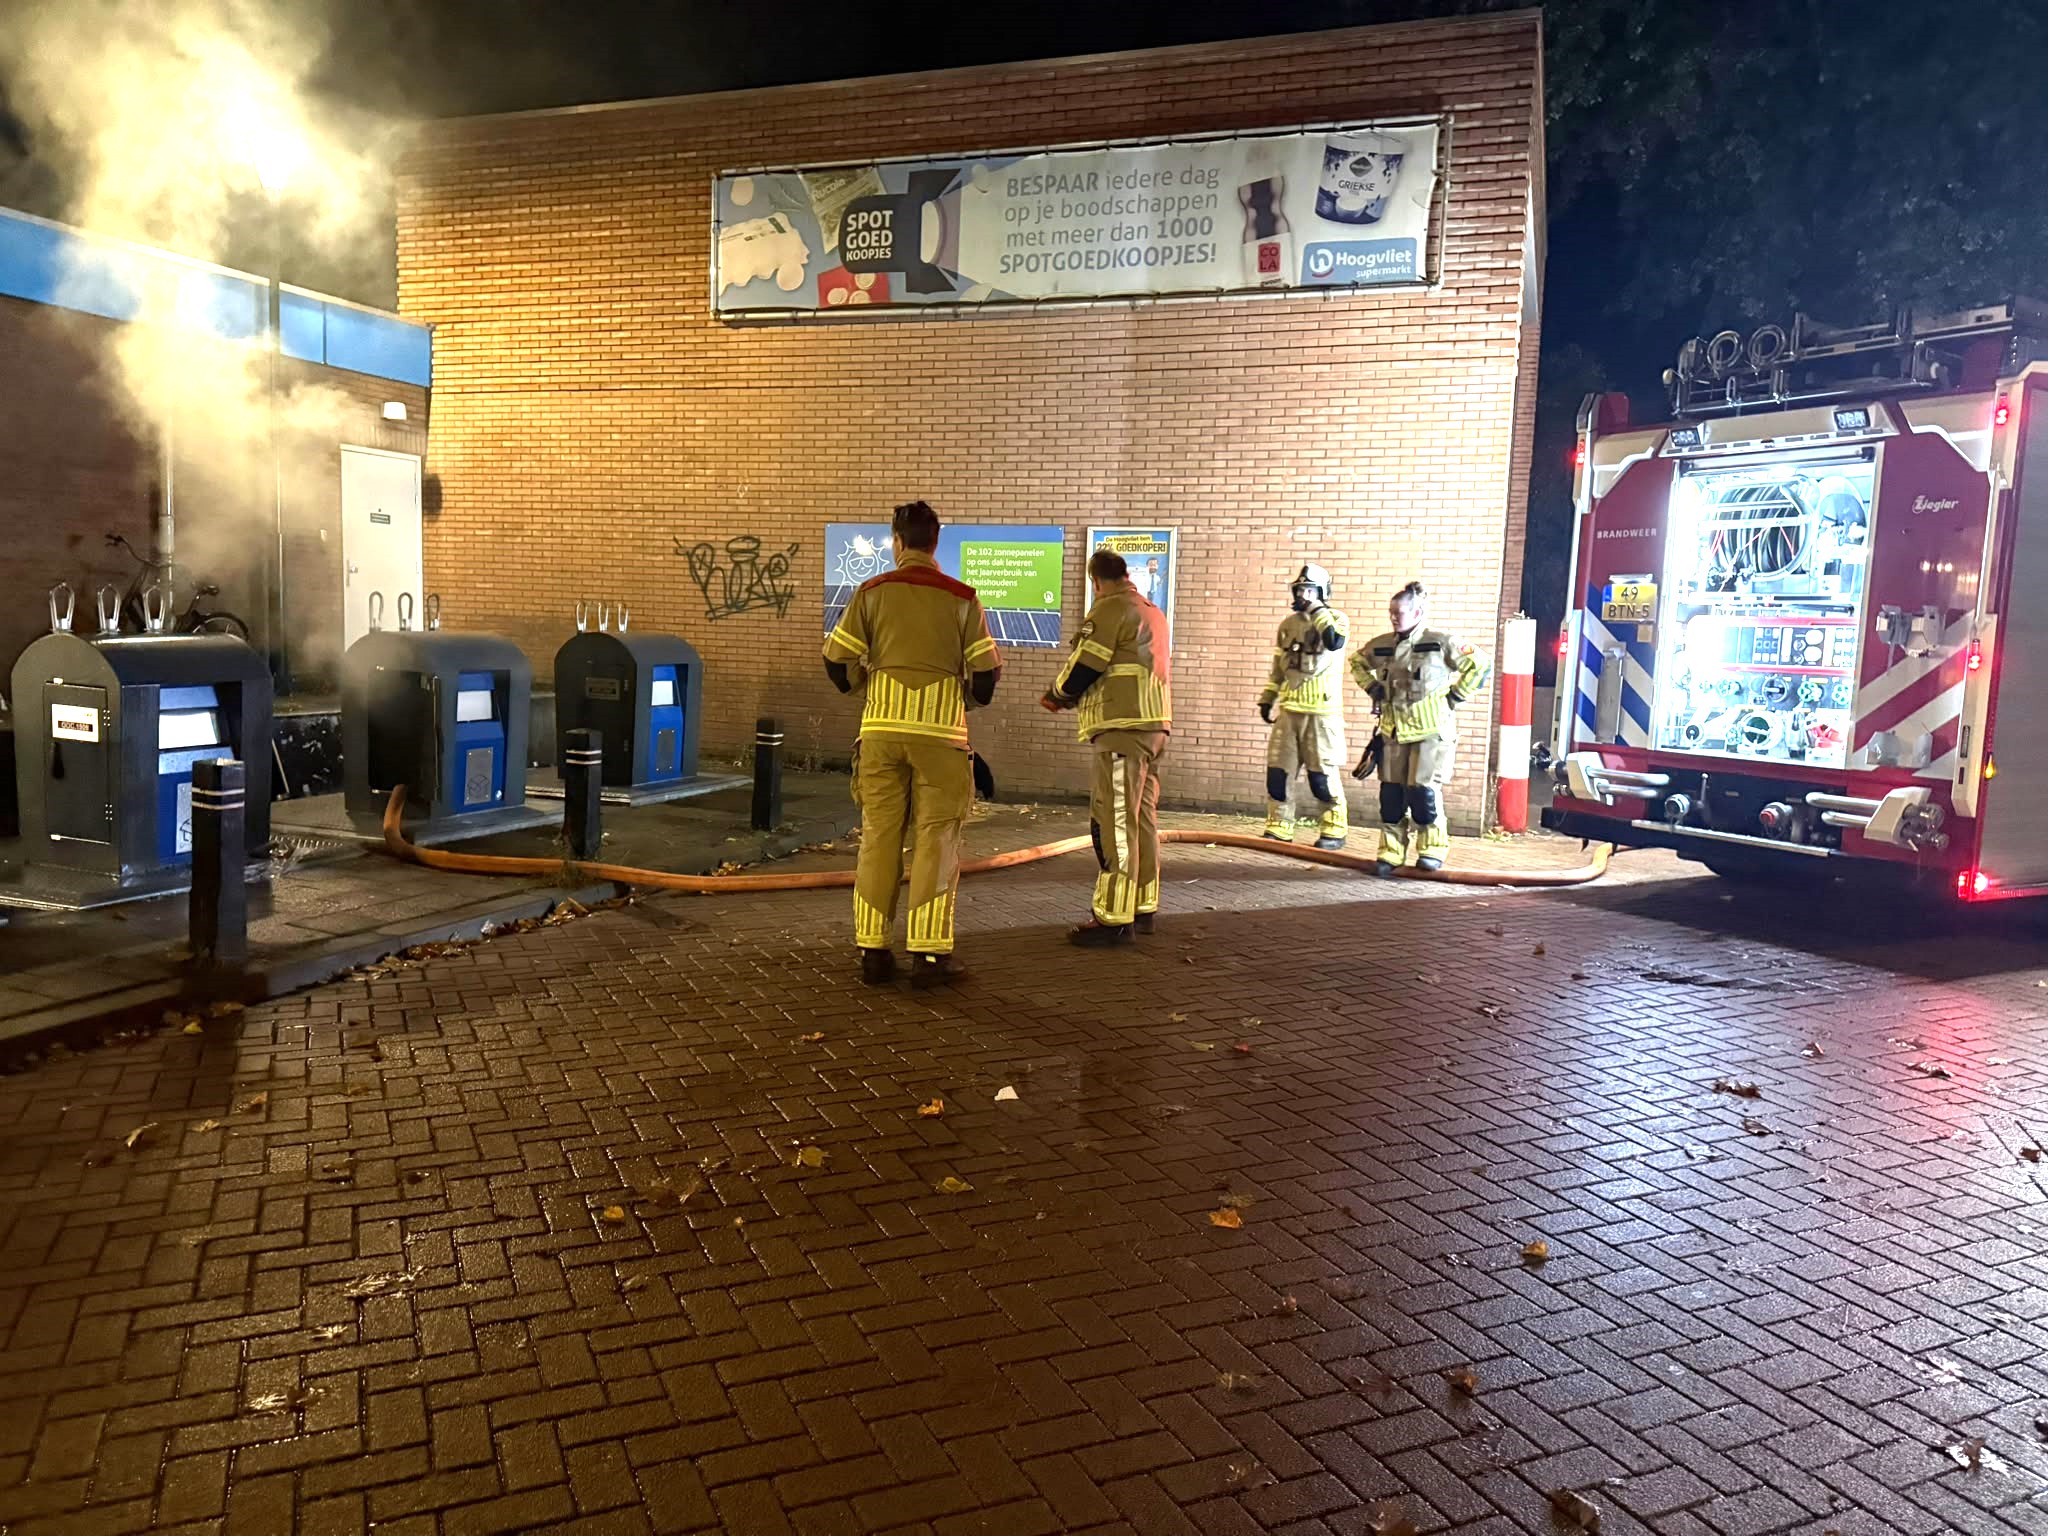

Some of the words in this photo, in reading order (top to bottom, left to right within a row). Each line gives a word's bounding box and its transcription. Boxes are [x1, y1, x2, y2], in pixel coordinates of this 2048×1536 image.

[1007, 172, 1098, 197] BESPAAR
[1105, 169, 1173, 190] iedere
[1180, 164, 1220, 189] dag
[1338, 179, 1375, 192] GRIEKSE
[812, 178, 846, 202] Rucola
[1005, 206, 1030, 226] op
[1035, 202, 1054, 224] je
[1061, 193, 1218, 219] boodschappen
[846, 210, 893, 231] SPOT
[846, 230, 893, 249] GOED
[1007, 229, 1045, 248] met
[1051, 228, 1104, 245] meer
[1110, 222, 1148, 242] dan
[1157, 216, 1213, 239] 1000
[846, 248, 892, 262] KOOPJES
[1000, 243, 1217, 273] SPOTGOEDKOOPJES!
[1336, 249, 1412, 268] Hoogvliet
[1356, 265, 1411, 279] supermarkt
[1912, 495, 1959, 514] Ziegler
[1596, 528, 1657, 539] BRANDWEER
[966, 547, 977, 556] De
[978, 548, 992, 556] 102
[994, 549, 1045, 558] zonnepanelen
[1116, 543, 1166, 553] GOEDKOPER!
[966, 568, 978, 576] het
[979, 569, 1022, 577] jaarverbruik
[966, 578, 972, 586] 6
[972, 578, 1018, 587] huishoudens
[980, 589, 1007, 599] energie
[1620, 586, 1639, 601] 49
